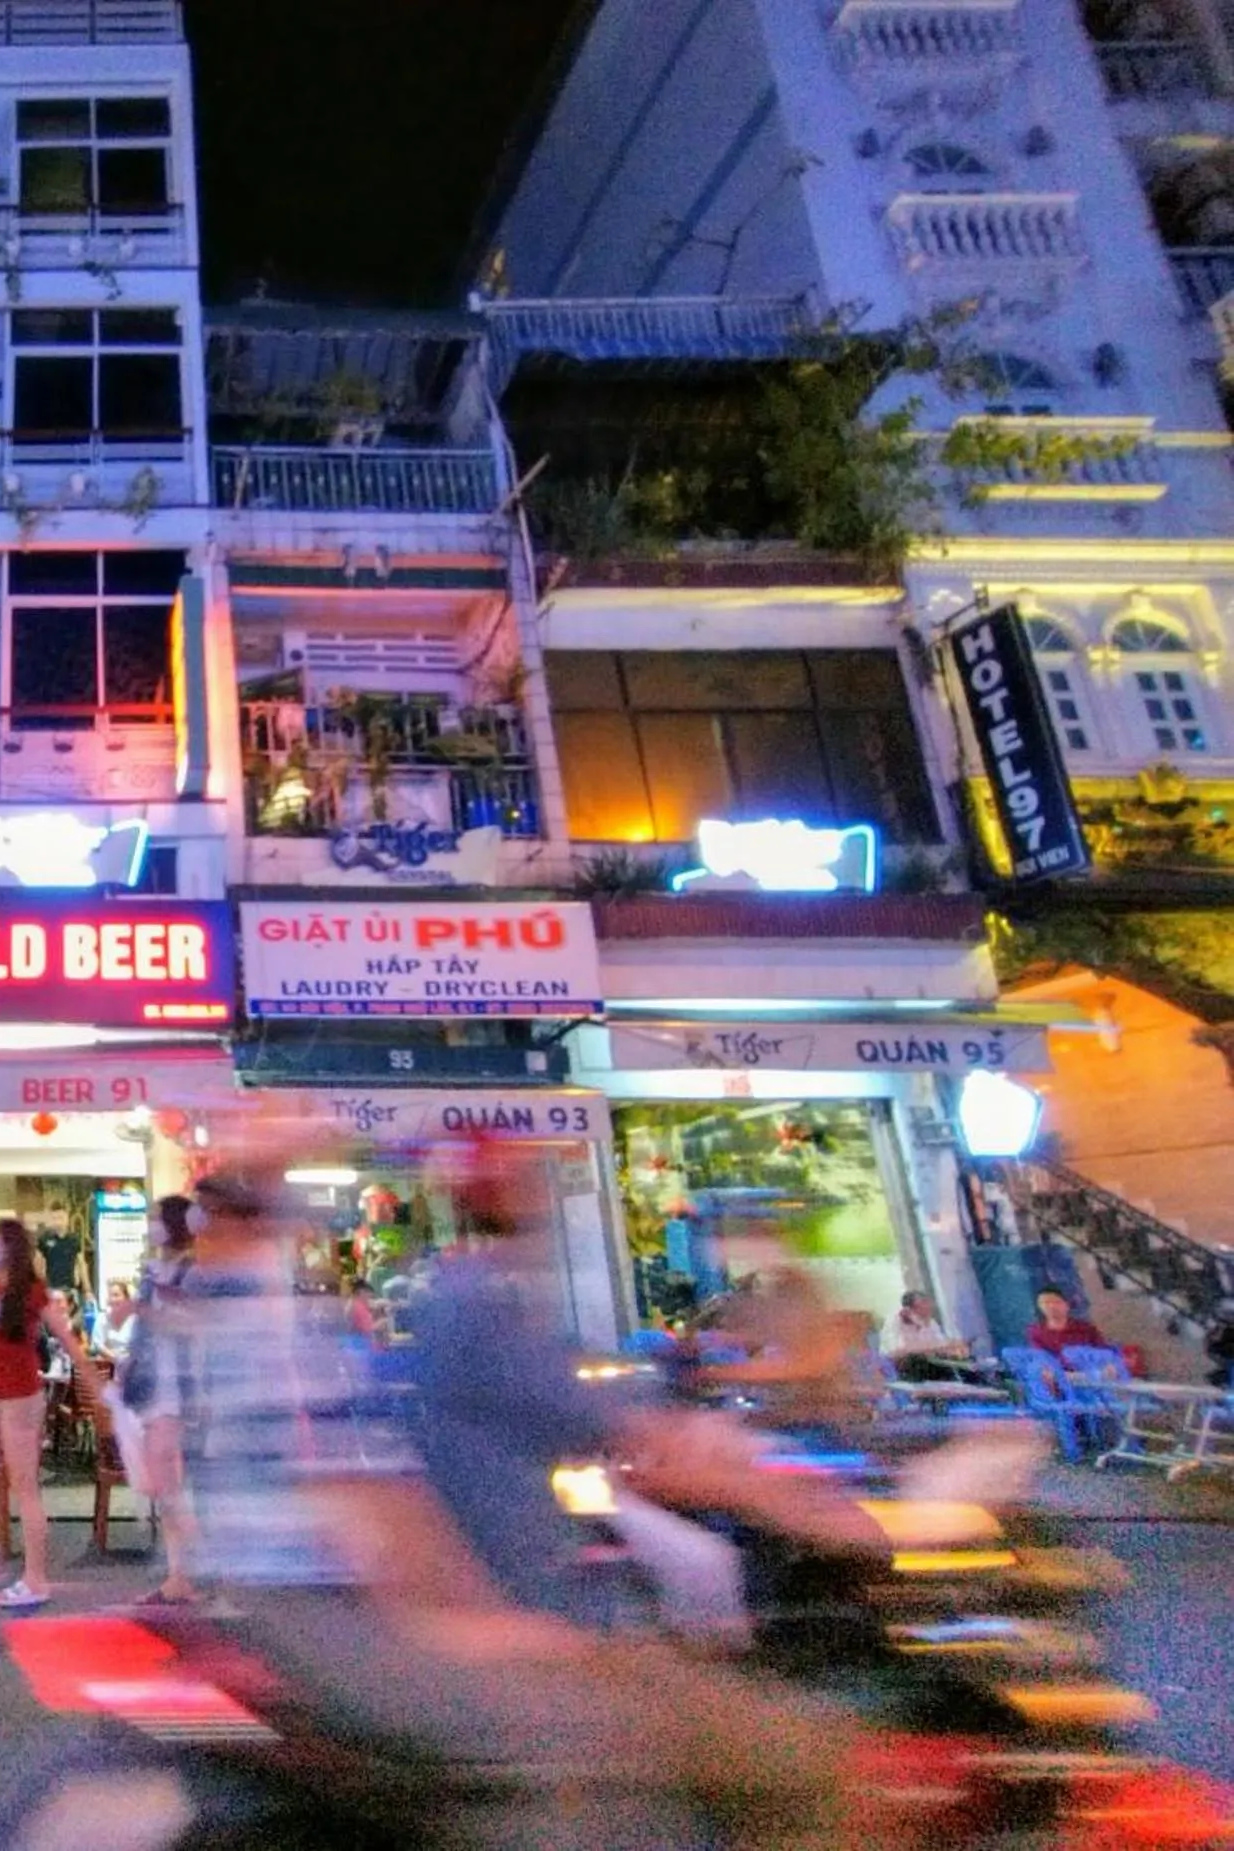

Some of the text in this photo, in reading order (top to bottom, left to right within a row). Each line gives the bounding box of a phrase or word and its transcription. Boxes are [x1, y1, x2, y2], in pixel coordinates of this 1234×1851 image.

[416, 909, 565, 950] PHÚ
[63, 923, 206, 981] BEER
[280, 980, 389, 997] LAUDRY
[424, 980, 569, 997] DRYCLEAN
[389, 1050, 414, 1069] 93
[715, 1031, 784, 1065] Tiger
[962, 1041, 1005, 1065] 95
[22, 1077, 149, 1104] BEER 91
[333, 1098, 397, 1132] Tiger
[548, 1106, 589, 1132] 93
